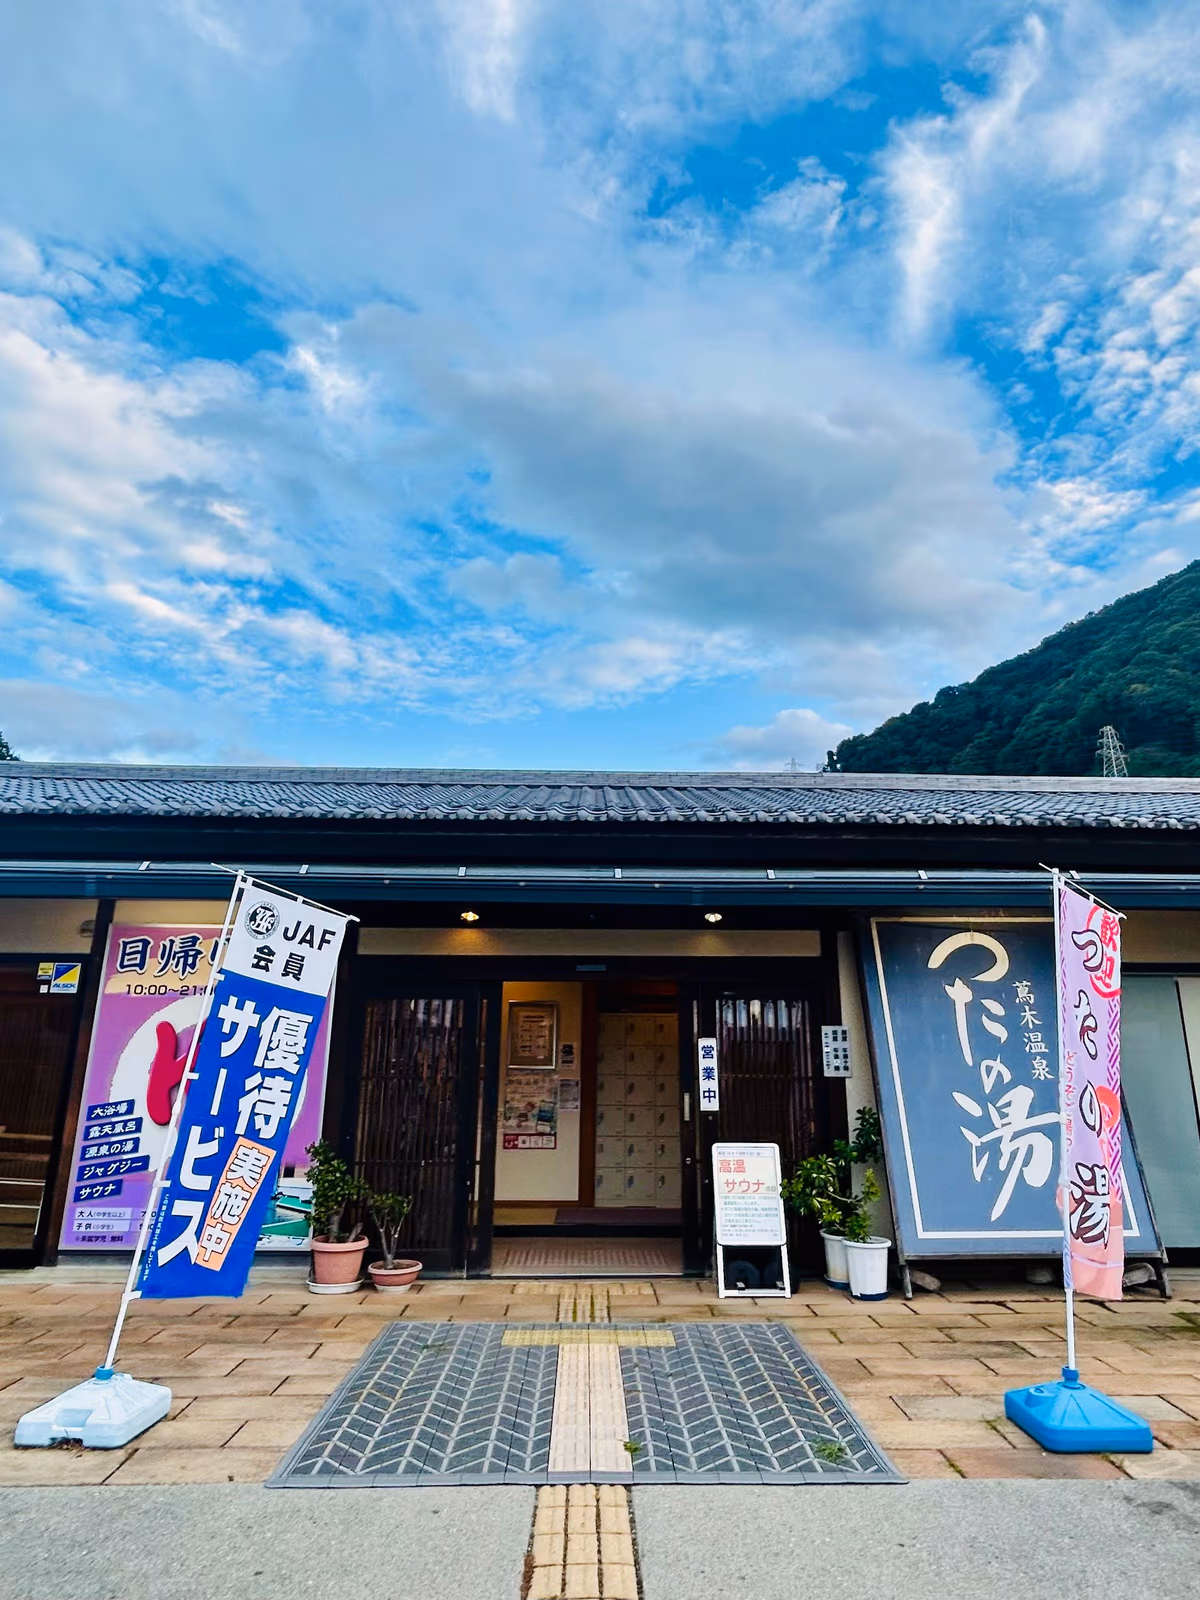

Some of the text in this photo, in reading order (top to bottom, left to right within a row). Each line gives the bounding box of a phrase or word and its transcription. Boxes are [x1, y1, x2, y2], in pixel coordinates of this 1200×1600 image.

[282, 920, 337, 951] JAF
[250, 944, 306, 982] 会員
[1012, 980, 1055, 1081] 蔦木温泉
[234, 1006, 314, 1141] 優待
[701, 1044, 717, 1104] 営業中
[927, 931, 1061, 1223] つたの湯
[1069, 928, 1110, 1250] つたの湯
[91, 1102, 128, 1118] 大浴場
[87, 1121, 136, 1139] 露天風呂
[158, 995, 260, 1267] サービス
[84, 1140, 135, 1158] 源泉の湯
[83, 1160, 143, 1179] ジャグジー
[719, 1159, 746, 1174] 高温
[79, 1184, 116, 1199] サウナ
[200, 1144, 271, 1262] 実施中
[724, 1179, 765, 1193] サウナ
